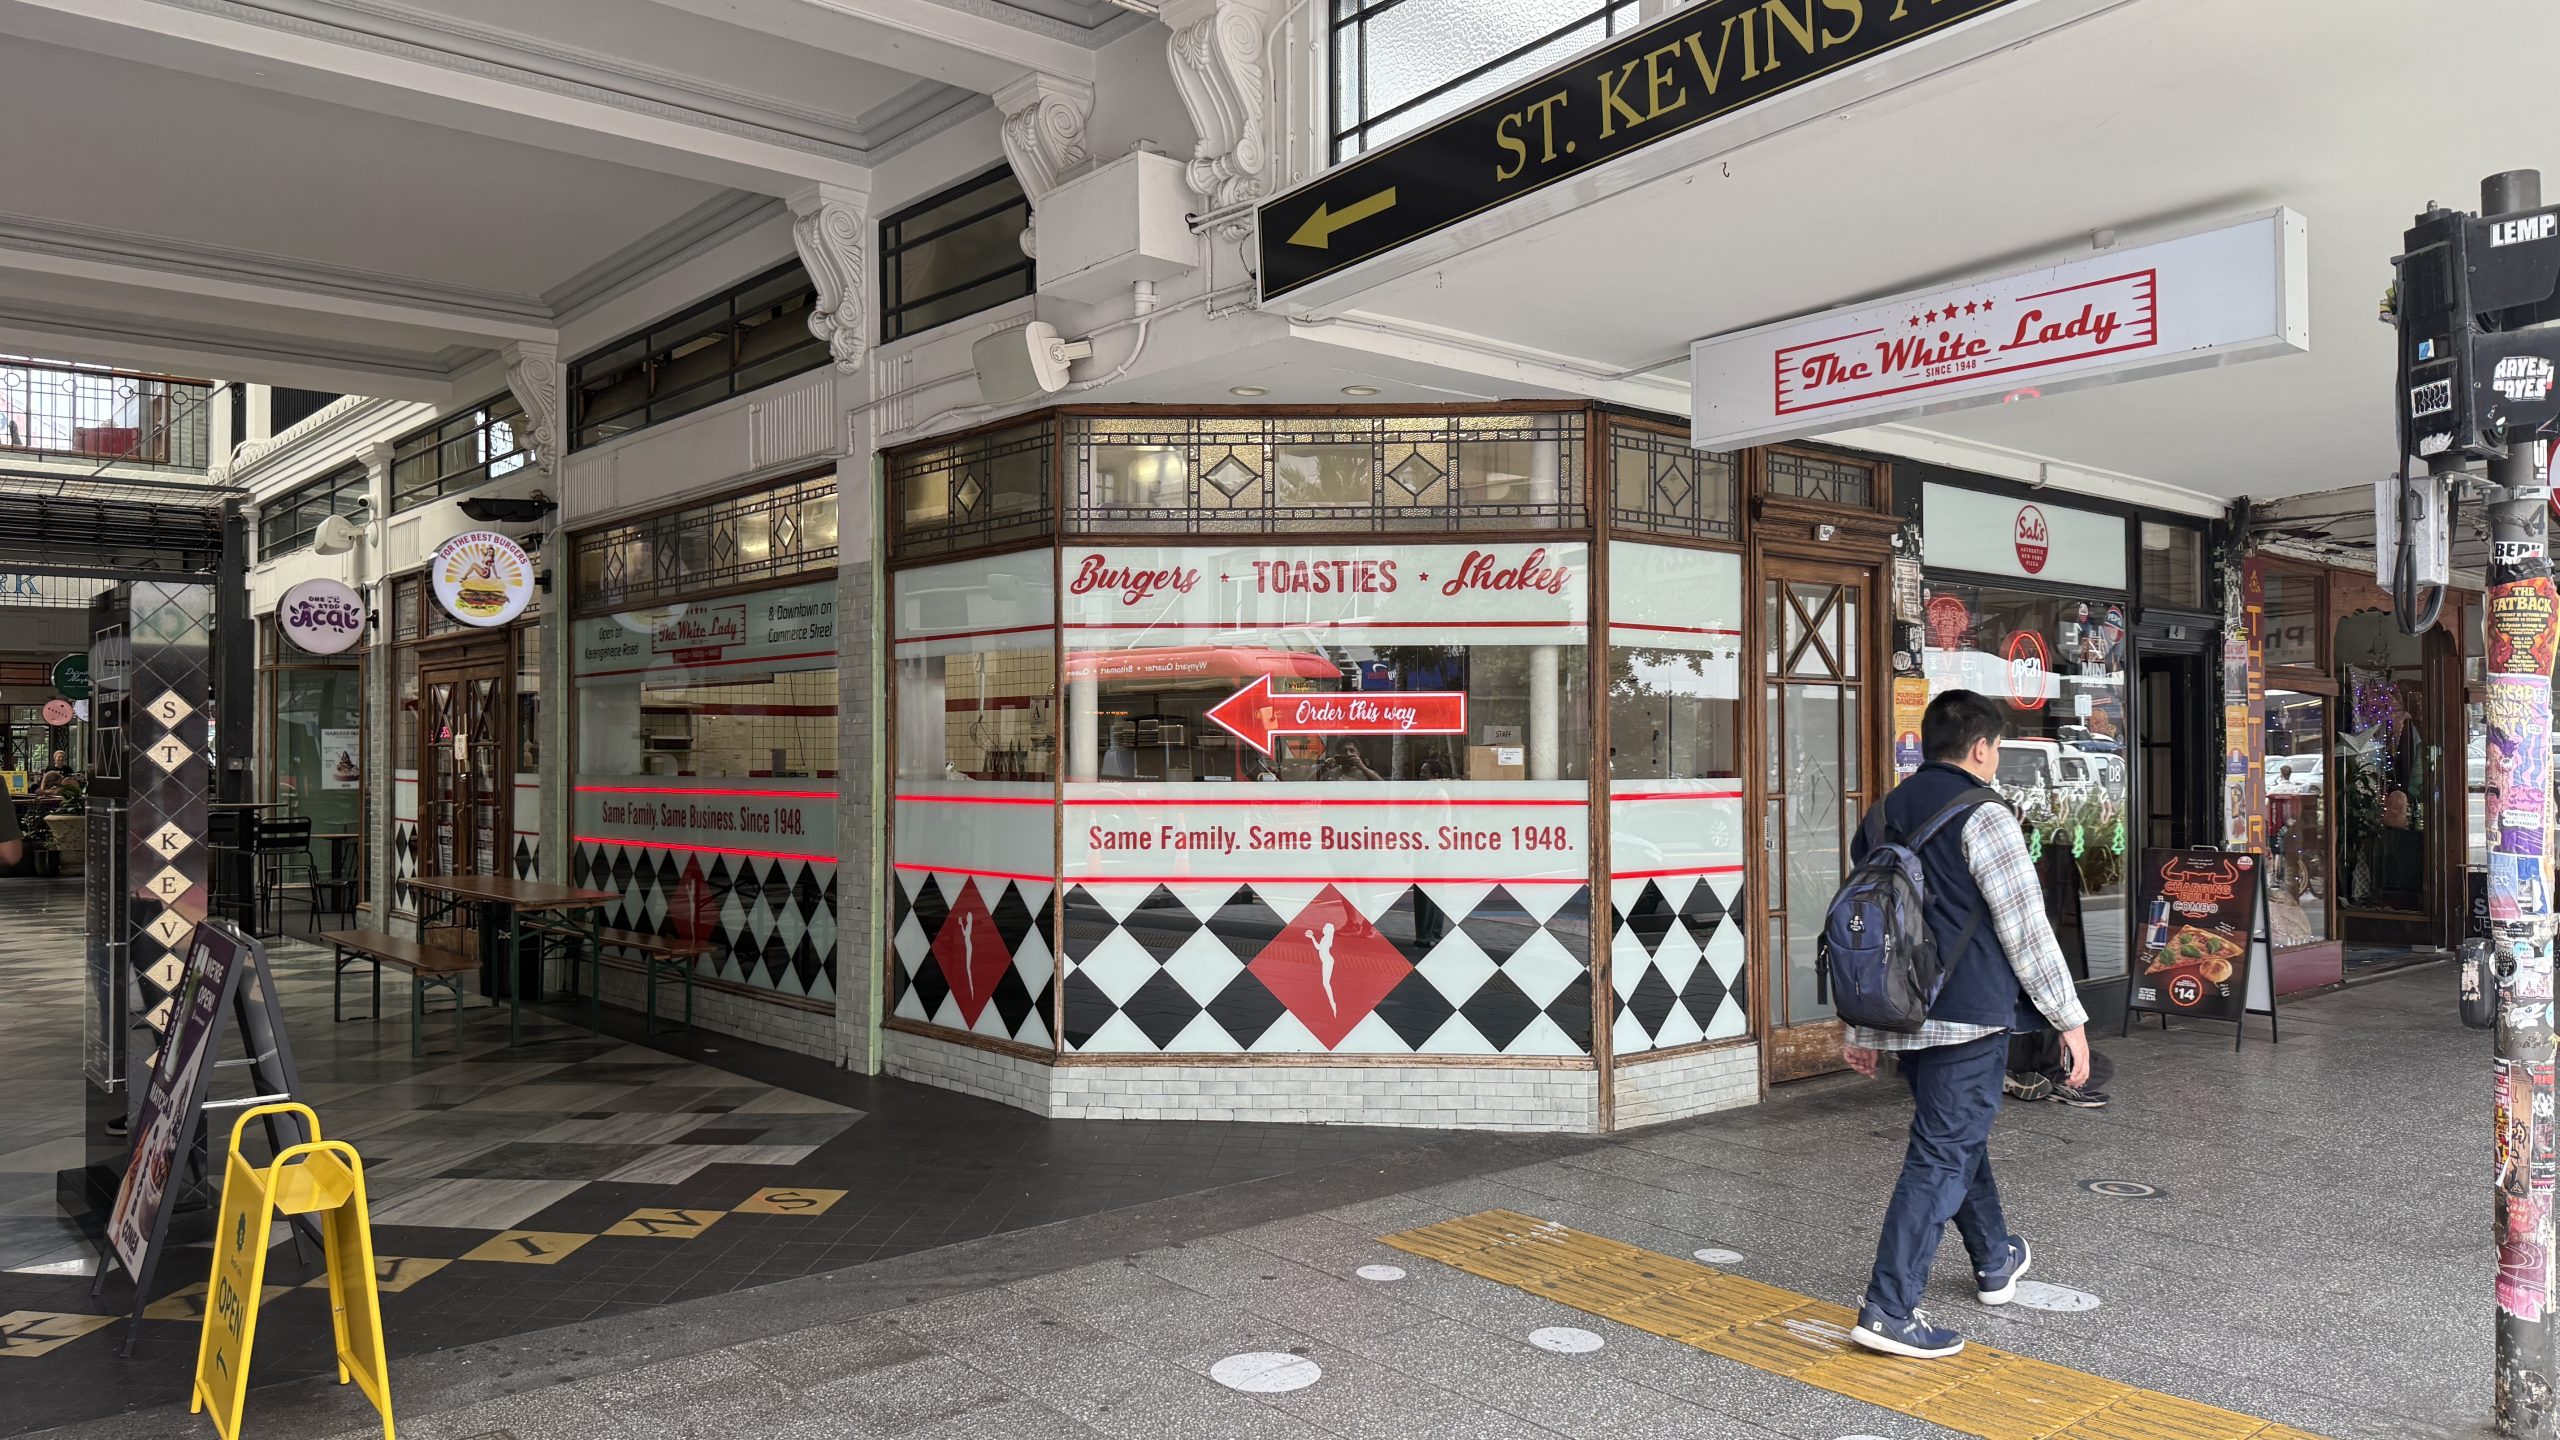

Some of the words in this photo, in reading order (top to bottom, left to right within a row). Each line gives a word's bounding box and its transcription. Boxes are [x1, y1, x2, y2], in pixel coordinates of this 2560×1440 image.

[1496, 89, 1577, 182] ST.
[1598, 0, 1863, 140] KEVINS
[2491, 214, 2556, 246] LEMP
[1802, 351, 1873, 390] The
[1875, 331, 1992, 374] White
[1999, 304, 2121, 351] Lady
[1926, 364, 1952, 378] SINCE
[1955, 359, 1977, 372] 1948
[2019, 516, 2045, 541] Sal's
[440, 544, 455, 560] FOR
[453, 535, 470, 548] THE
[470, 533, 493, 542] BEST
[493, 536, 528, 564] BURGERS
[1070, 554, 1201, 606] Burgers
[1252, 560, 1397, 593] TOASTIES
[1442, 548, 1572, 596] Shakes
[2512, 587, 2535, 597] THE
[768, 607, 774, 620] &
[777, 604, 818, 620] Downtown
[820, 602, 832, 614] on
[2493, 597, 2552, 613] FATBACK
[599, 627, 612, 641] Open
[614, 628, 623, 639] on
[659, 624, 677, 641] The
[678, 620, 706, 639] White
[708, 616, 737, 640] Lady
[768, 628, 807, 643] Commerce
[809, 624, 832, 639] Street
[622, 643, 638, 657] Road
[1296, 700, 1345, 724] Order
[1349, 699, 1379, 722] this
[1384, 706, 1417, 729] way
[1495, 730, 1512, 738] STAFF
[2247, 717, 2264, 853] THIR
[602, 800, 625, 824] Same
[628, 802, 658, 831] Family.
[661, 803, 687, 828] Same
[689, 804, 736, 831] Business.
[740, 807, 769, 833] Since
[774, 808, 804, 836] 1948.
[1090, 826, 1152, 849] Same
[1161, 825, 1241, 854] Family.
[1249, 826, 1312, 849] Same
[1321, 825, 1430, 850] Business.
[1438, 825, 1501, 850] Since
[1512, 826, 1574, 850] 1948.
[2165, 881, 2231, 895] CHARGING
[2173, 901, 2218, 913] COMBO
[2174, 986, 2195, 1000] $14
[218, 1275, 244, 1344] OPEN
